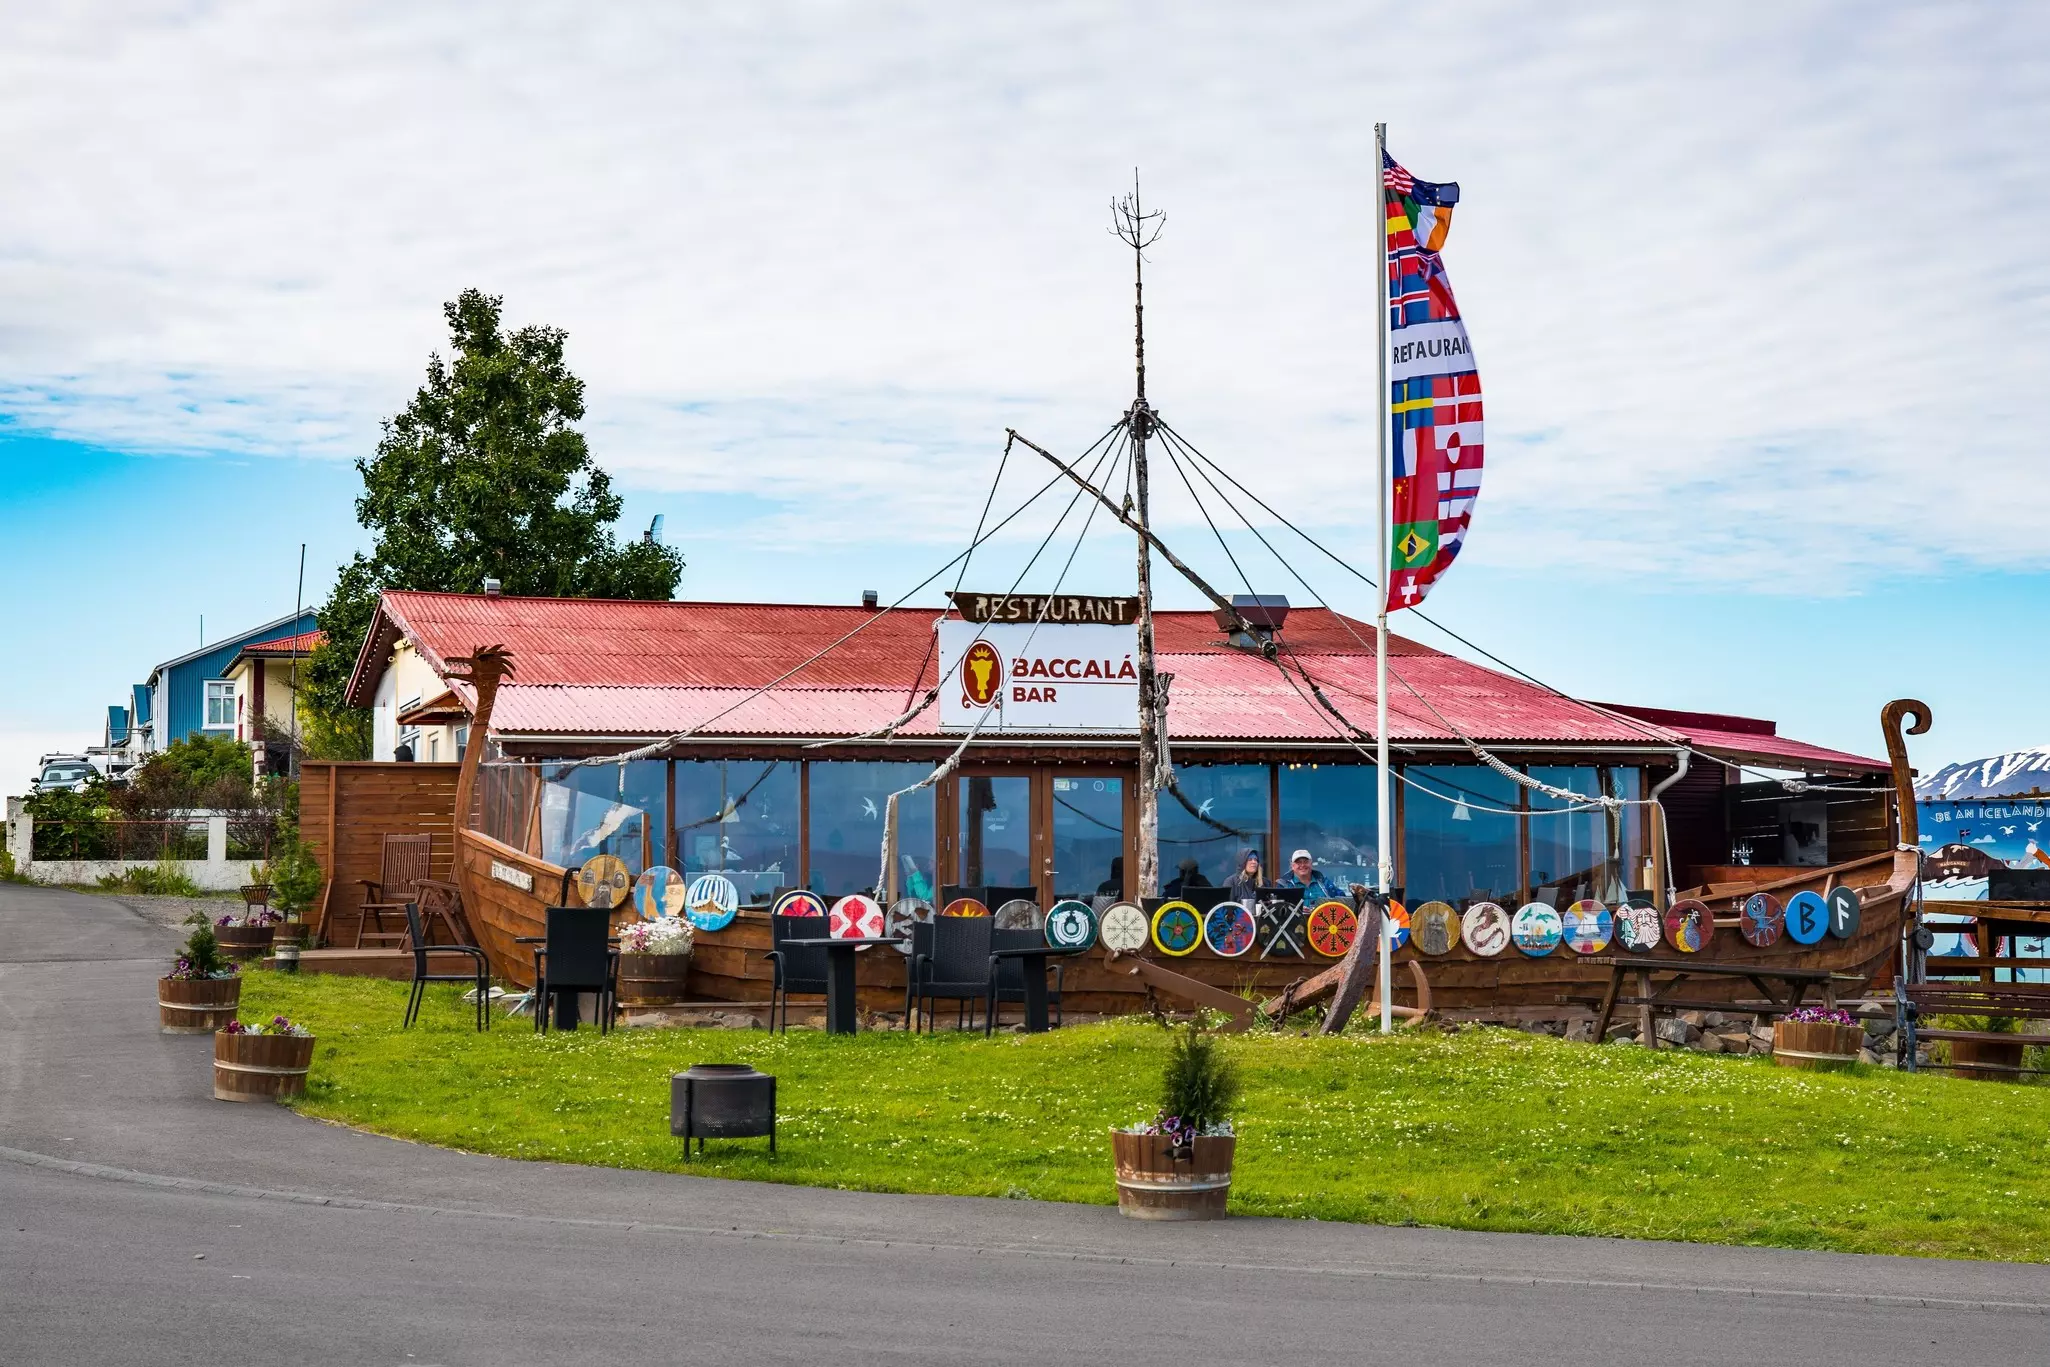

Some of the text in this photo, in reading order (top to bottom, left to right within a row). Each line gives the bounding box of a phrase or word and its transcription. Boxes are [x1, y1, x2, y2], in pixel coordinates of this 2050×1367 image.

[975, 596, 1127, 621] RESTAURANT
[1012, 655, 1137, 679] BACCALÁ
[1012, 687, 1057, 703] BAR
[1935, 812, 1951, 822] BE
[1955, 809, 1974, 819] AN
